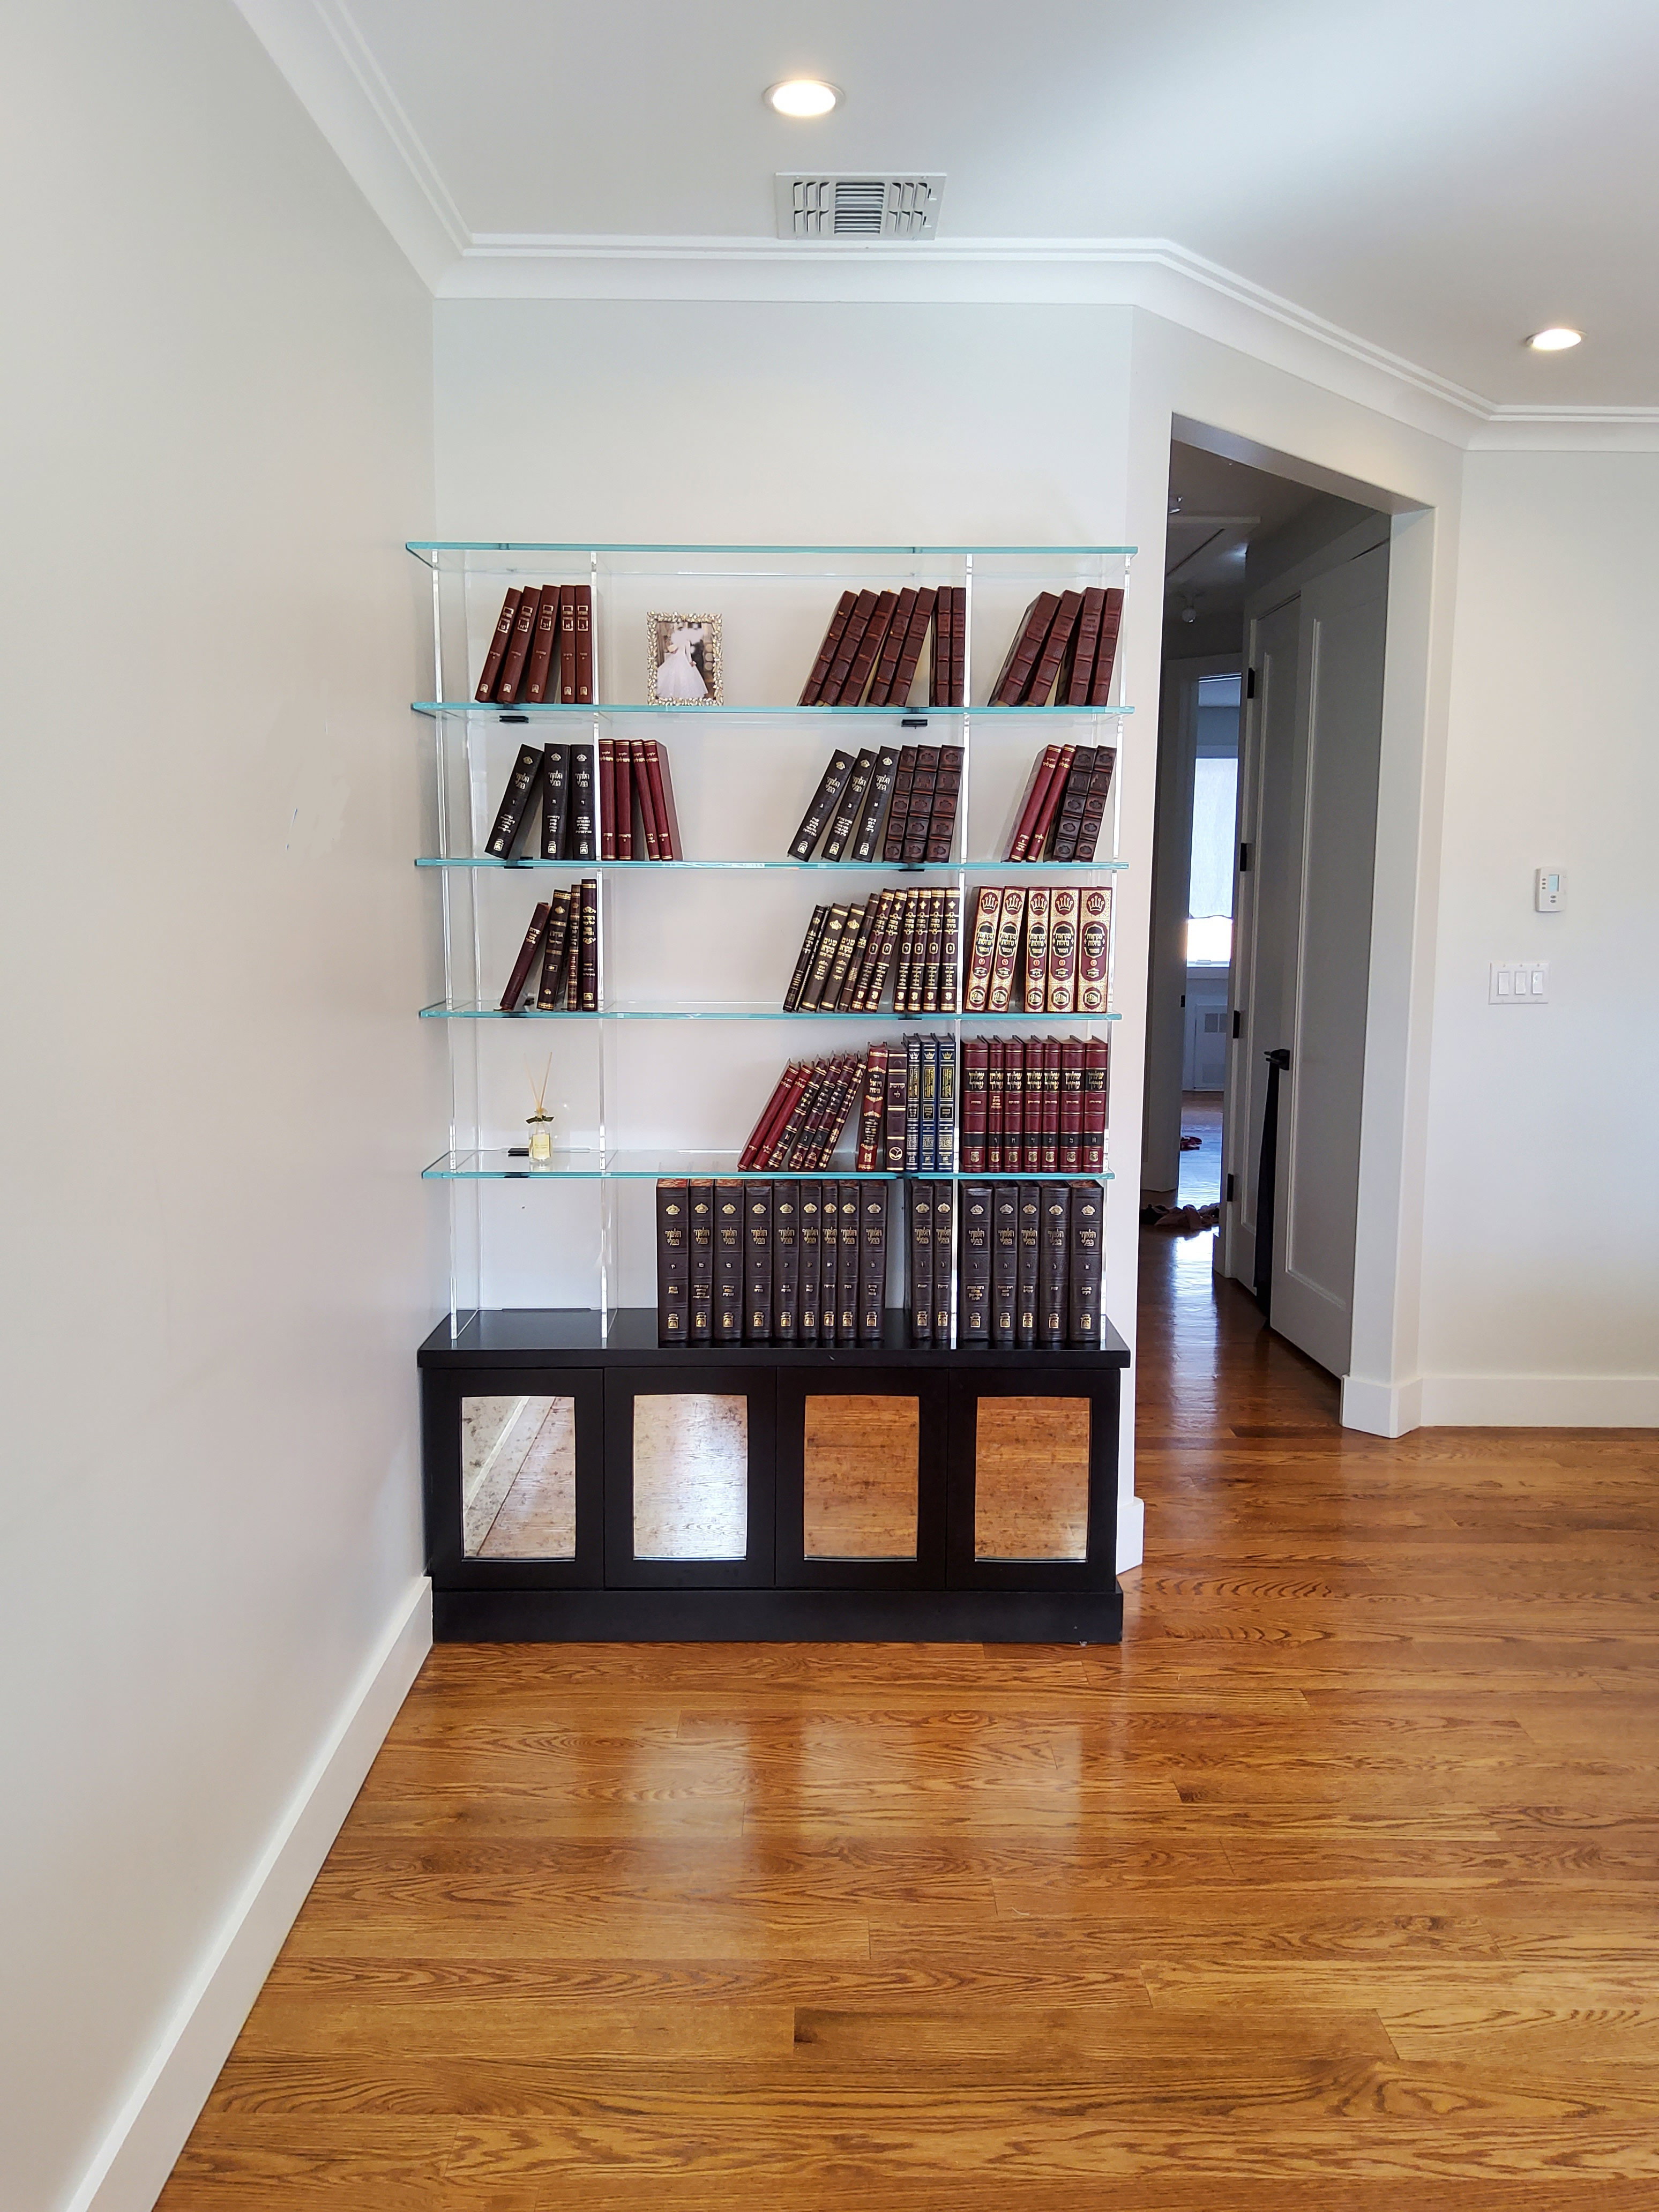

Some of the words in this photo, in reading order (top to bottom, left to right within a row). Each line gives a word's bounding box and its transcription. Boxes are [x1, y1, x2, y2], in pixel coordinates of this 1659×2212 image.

[823, 937, 837, 946] שנים
[841, 937, 855, 946] שנים
[821, 944, 835, 954] מקרא
[839, 944, 853, 953] מקרא
[870, 1078, 882, 1087] ויואל
[665, 1228, 681, 1239] תלמוד
[693, 1227, 709, 1238] תלמוד
[721, 1227, 737, 1238] תלמוד
[751, 1227, 767, 1238] תלמוד
[779, 1227, 795, 1238] תלמוד
[802, 1227, 818, 1238] תלמוד
[823, 1227, 837, 1238] תלמוד
[841, 1227, 857, 1238] תלמוד
[866, 1227, 882, 1238] תלמוד
[914, 1227, 931, 1238] תלמוד
[936, 1227, 951, 1238] תלמוד
[969, 1228, 985, 1239] תלמוד
[998, 1228, 1014, 1239] תלמוד
[1021, 1228, 1037, 1239] תלמוד
[1048, 1228, 1064, 1239] תלמוד
[1080, 1228, 1096, 1240] תלמוד
